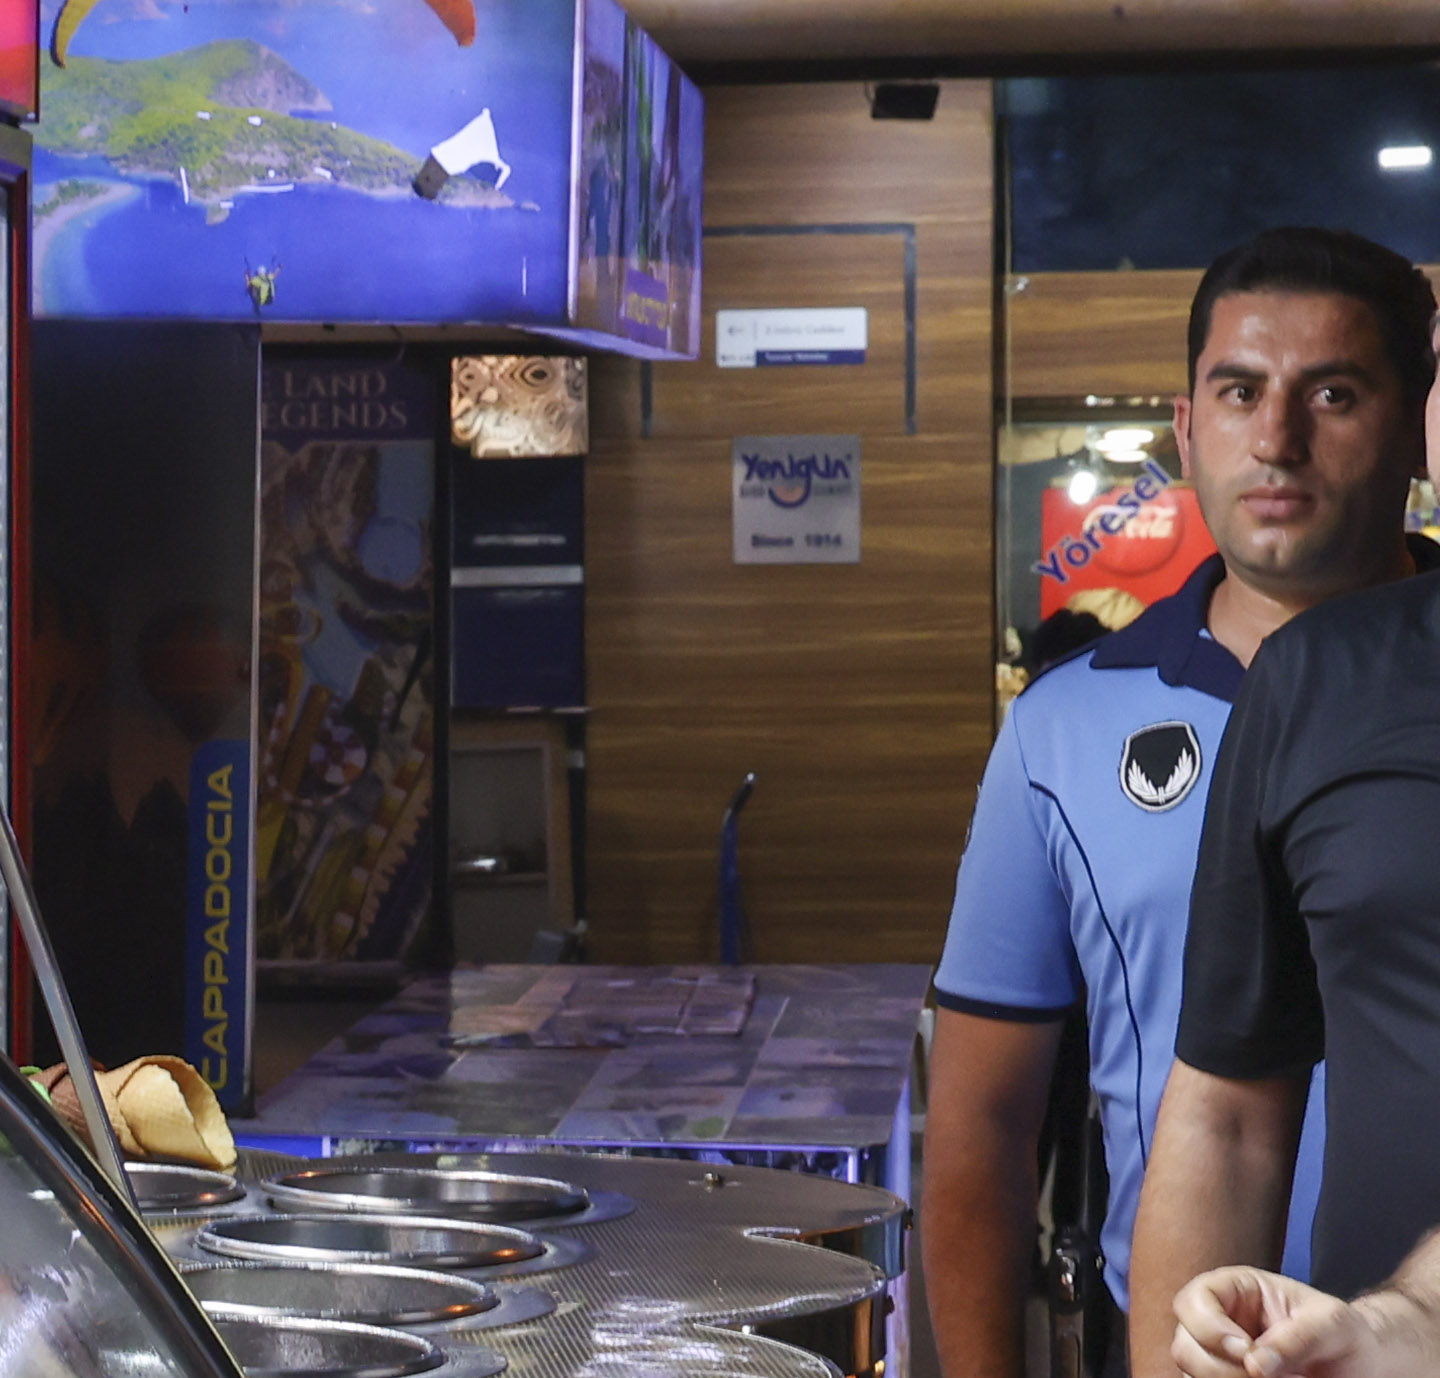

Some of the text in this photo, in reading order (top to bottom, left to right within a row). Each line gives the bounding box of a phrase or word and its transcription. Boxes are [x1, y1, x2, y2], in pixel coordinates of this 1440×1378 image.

[261, 402, 408, 431] EGENDS
[284, 371, 387, 397] LAND
[1032, 458, 1171, 583] Yöresel
[201, 764, 234, 1090] CAPPADOCIA
